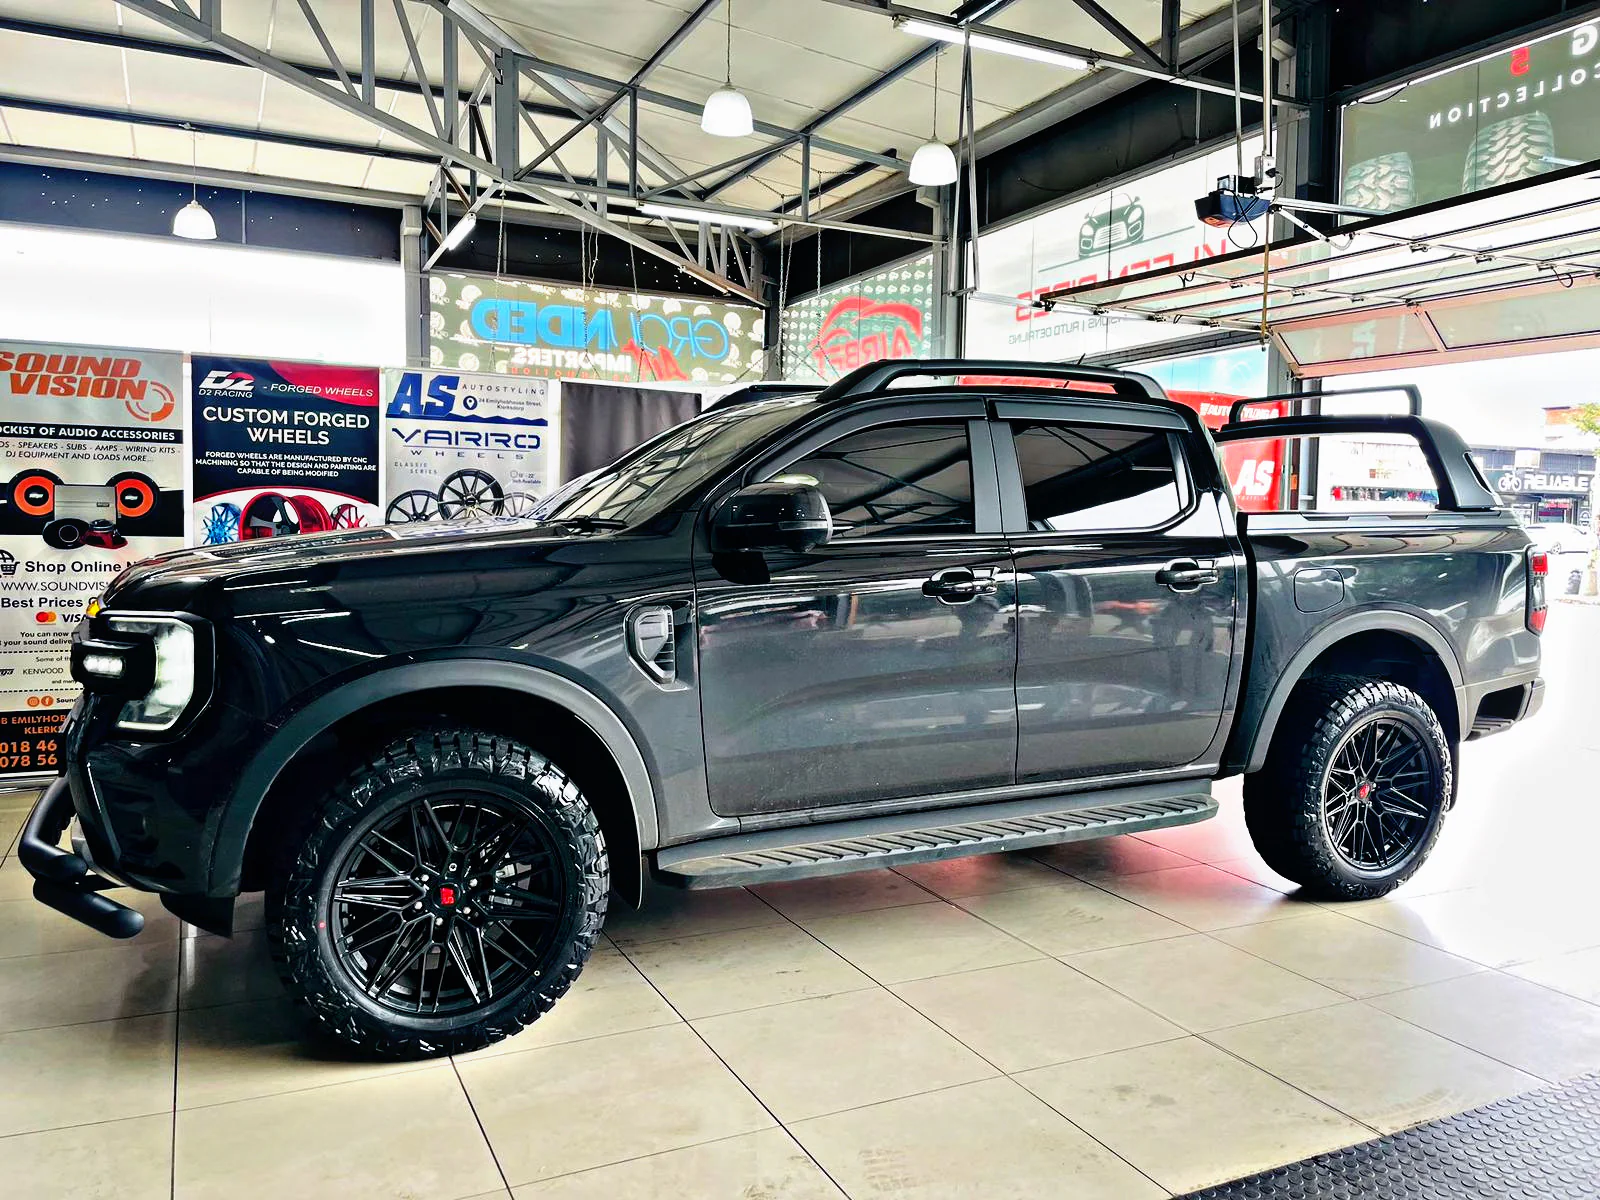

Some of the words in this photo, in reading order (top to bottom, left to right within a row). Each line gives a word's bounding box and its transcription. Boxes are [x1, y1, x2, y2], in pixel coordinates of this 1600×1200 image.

[10, 373, 148, 400] VISION
[270, 383, 322, 395] FORGED
[325, 386, 374, 397] WHEELS
[462, 383, 545, 395] AUTOSTYLING
[214, 390, 253, 398] RACING
[386, 373, 460, 416] AS
[202, 406, 288, 425] CUSTOM
[293, 412, 370, 429] FORGED
[0, 425, 36, 435] CKIST
[39, 427, 56, 436] OF
[58, 428, 97, 438] AUDIO
[101, 430, 175, 440] ACCESSORIES
[247, 427, 330, 445] WHEELS
[18, 441, 58, 449] SPEAKERS
[66, 443, 87, 451] SUBS
[94, 444, 118, 452] AMPS
[125, 446, 157, 454] WIRING
[159, 446, 176, 454] KITS
[6, 450, 16, 458] DJ
[18, 450, 69, 459] EQUIPMENT
[71, 452, 91, 460] AND
[93, 453, 121, 461] LOADS
[205, 451, 236, 459] FORGED
[236, 452, 267, 460] WHEELS
[283, 454, 342, 462] MANUFACTURED
[411, 449, 524, 460] WHEELS
[195, 458, 239, 466] MACHINING
[251, 460, 270, 468] THAT
[286, 461, 313, 469] DESIGN
[330, 463, 363, 471] PAINTING
[1233, 459, 1275, 496] AS
[1523, 474, 1590, 492] RELIABLE
[25, 560, 66, 574] Shop
[71, 560, 122, 573] Online
[1, 581, 108, 592] WWW.SOUNDVIS
[1, 597, 34, 608] Best
[38, 596, 84, 608] Prices
[4, 639, 21, 647] your
[23, 638, 48, 646] sound
[22, 667, 64, 675] KENWOOD
[0, 741, 31, 753] 018
[36, 740, 58, 751] 46
[0, 754, 31, 768] 078
[36, 754, 58, 766] 56
